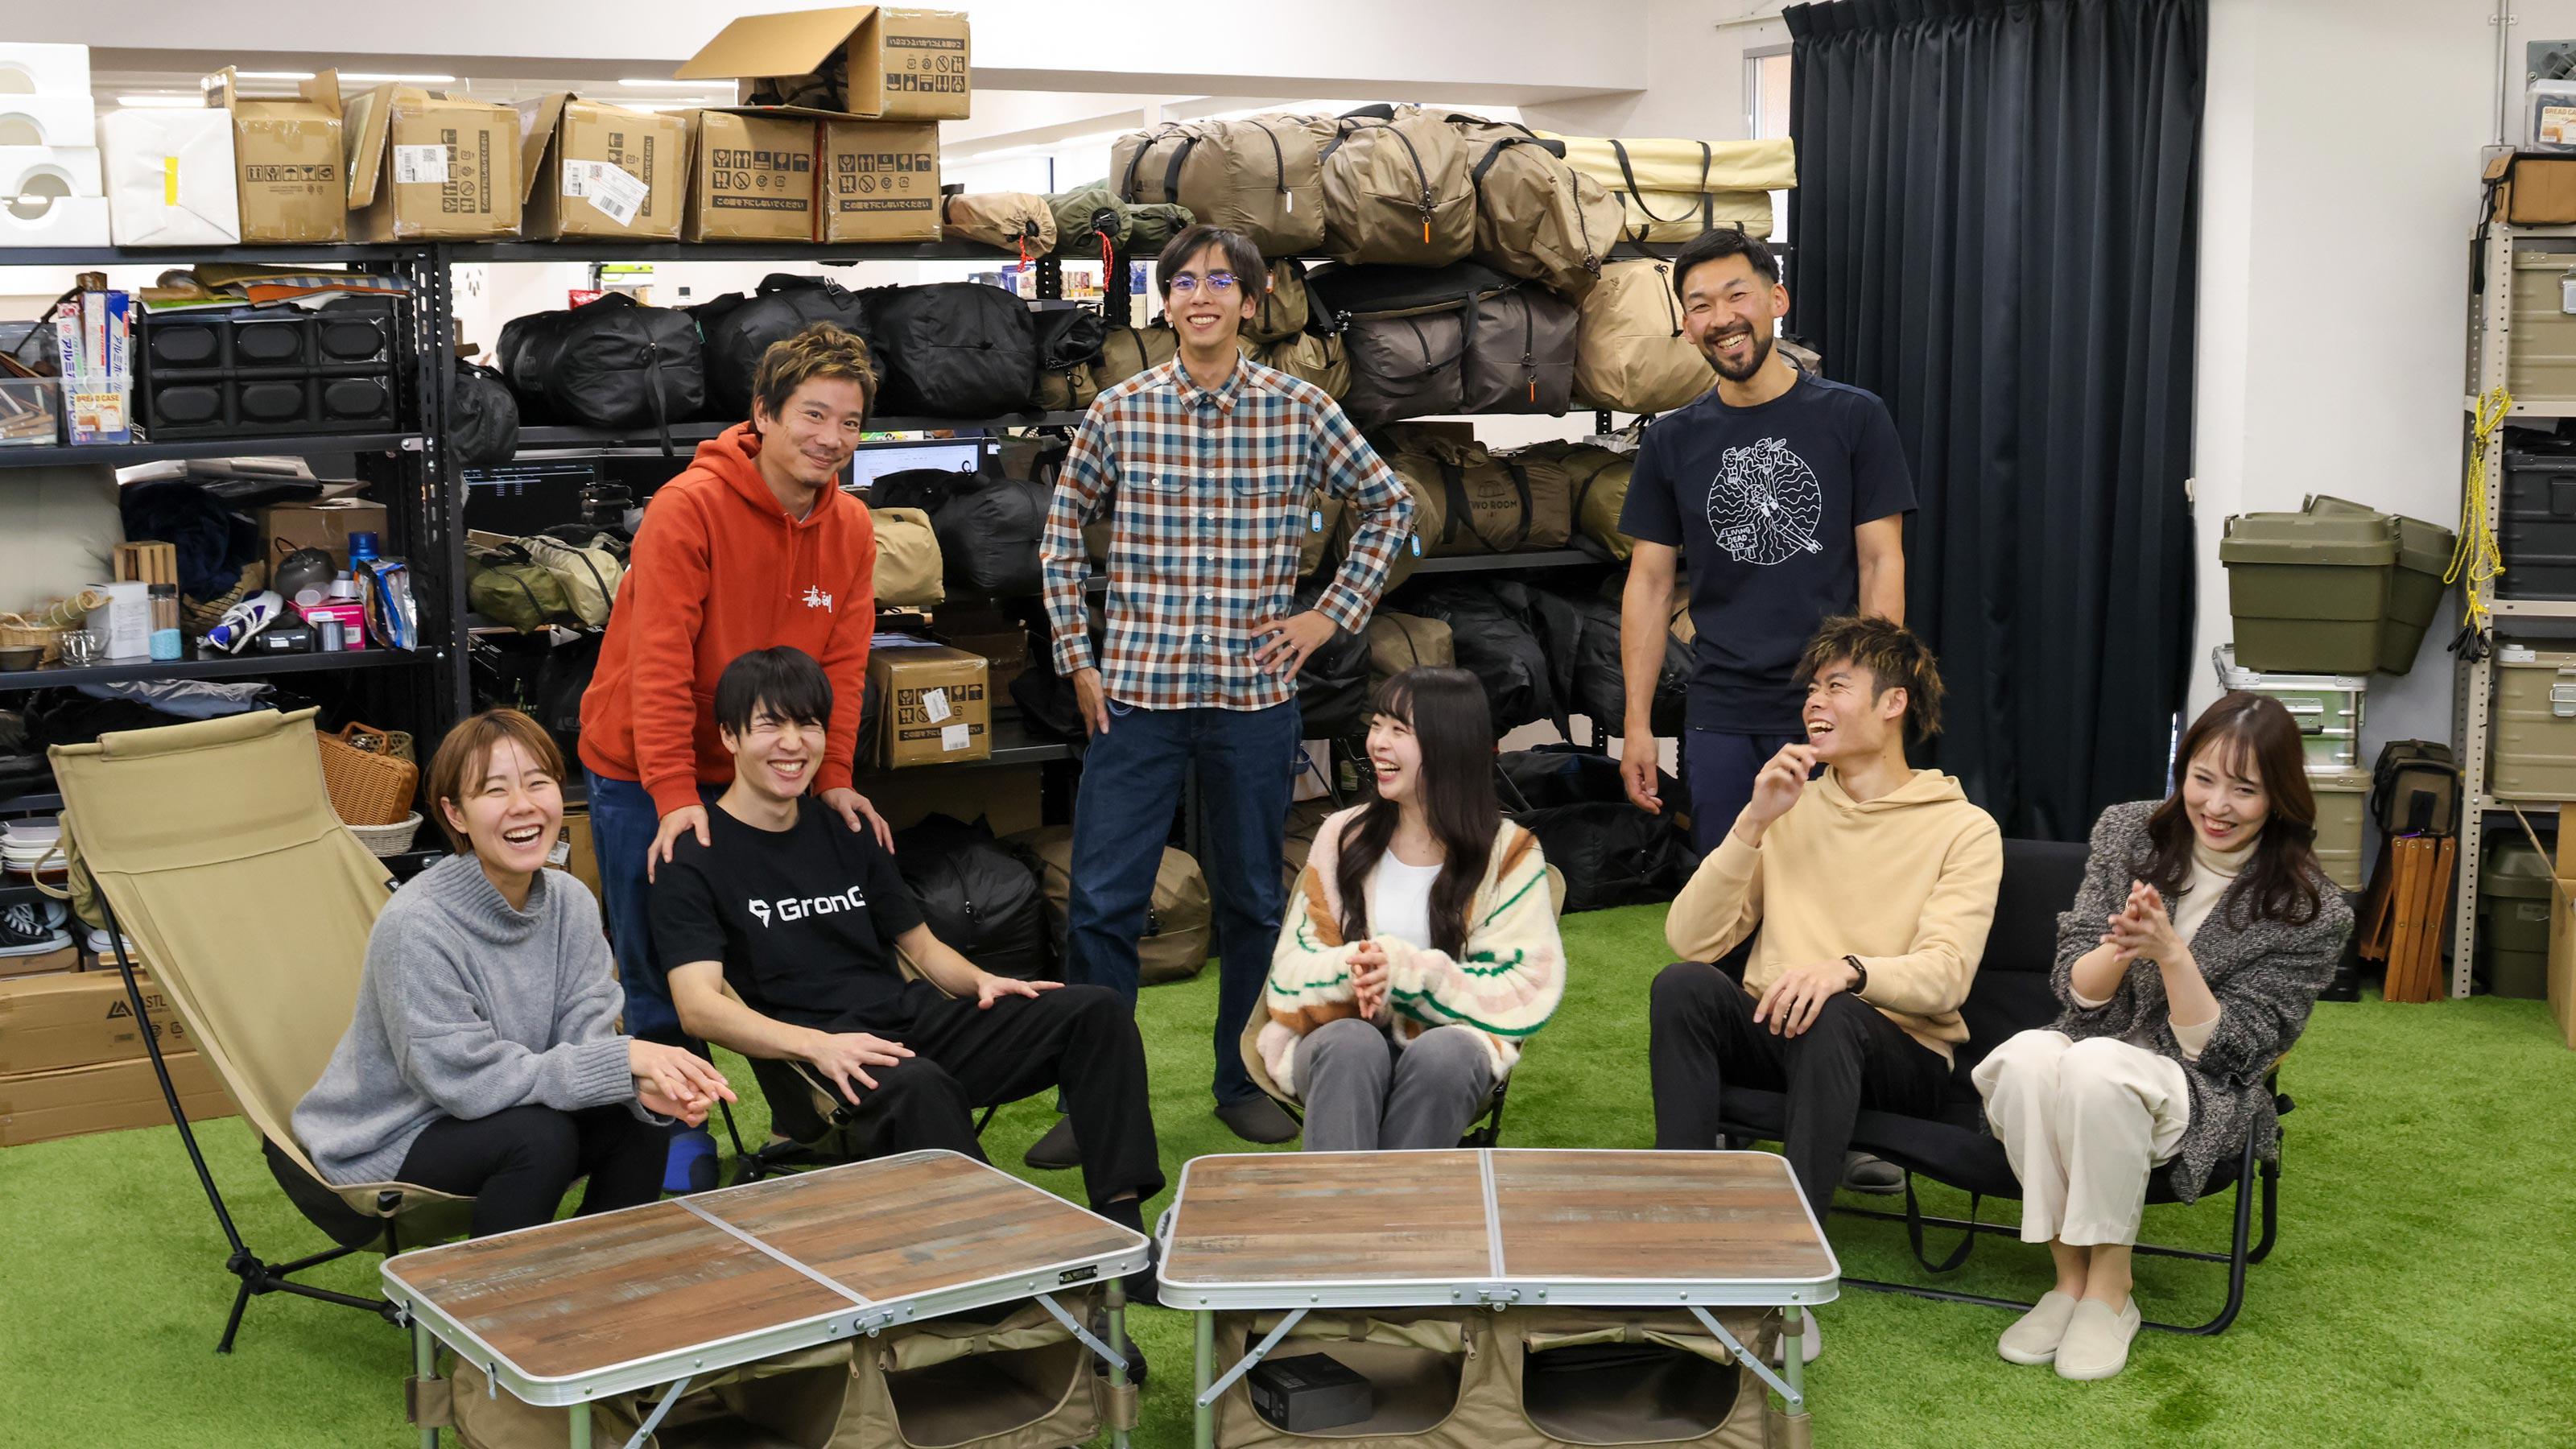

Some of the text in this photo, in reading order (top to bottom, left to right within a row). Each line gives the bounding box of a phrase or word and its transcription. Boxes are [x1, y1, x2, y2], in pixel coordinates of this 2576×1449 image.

[113, 334, 122, 393] アルミホル
[1490, 500, 1517, 510] ROOM
[1725, 526, 1751, 536] LIVING
[1727, 535, 1748, 544] DEAD
